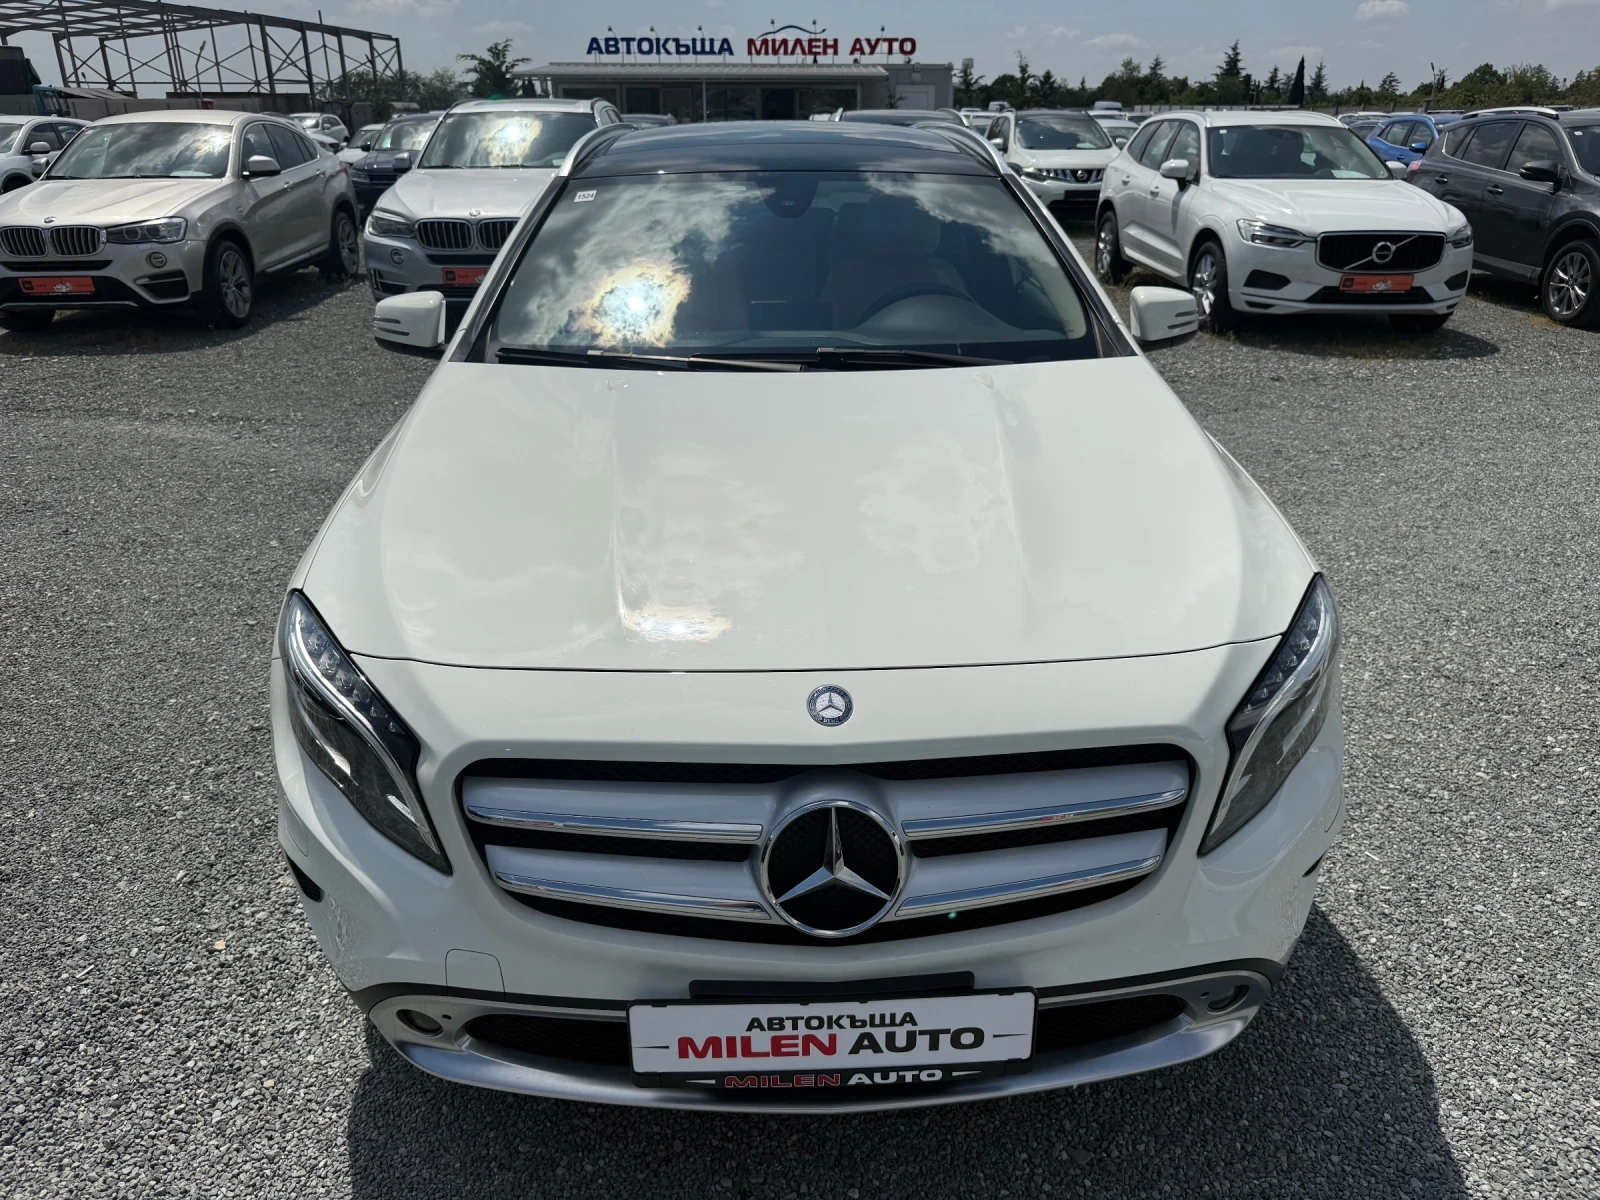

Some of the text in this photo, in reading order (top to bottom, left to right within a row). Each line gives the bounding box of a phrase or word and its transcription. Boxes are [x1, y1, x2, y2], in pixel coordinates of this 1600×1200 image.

[586, 37, 917, 56] АВТОКЪЩА МИЛЕН АУТО
[745, 1012, 918, 1032] АВТОКЪЩА
[677, 1027, 985, 1059] MILEN AUTO
[724, 1069, 943, 1088] MILEN AUTO
